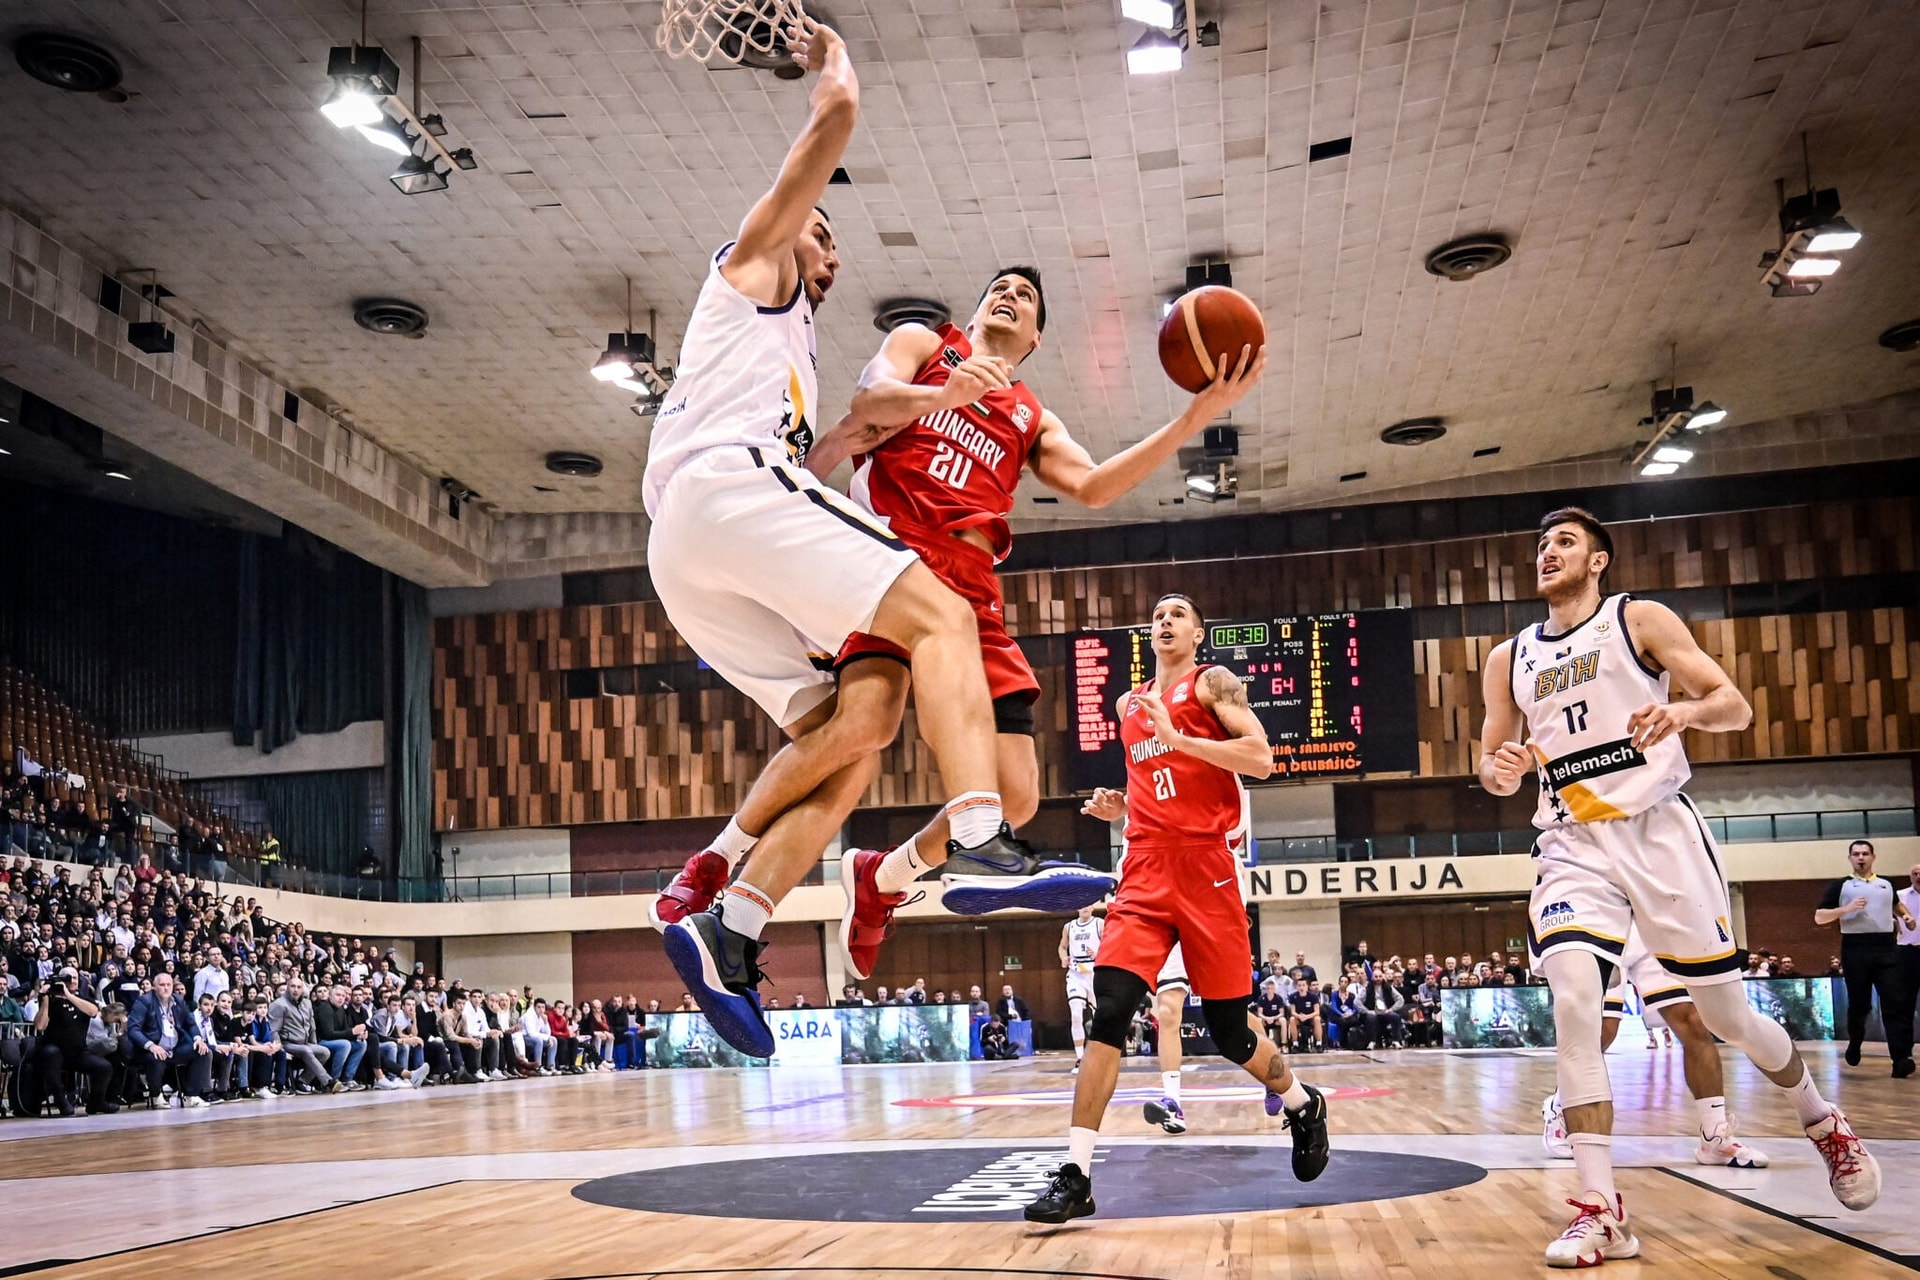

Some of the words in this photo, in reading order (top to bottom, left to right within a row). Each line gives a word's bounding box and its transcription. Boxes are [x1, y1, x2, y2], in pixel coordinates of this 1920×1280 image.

[927, 440, 973, 490] 20
[1273, 617, 1297, 625] FOULS
[1348, 618, 1356, 628] 2
[1215, 626, 1264, 646] 08:38
[1281, 624, 1291, 639] 0
[1310, 659, 1321, 670] 11
[1311, 669, 1322, 679] 12
[1271, 676, 1295, 695] 64
[1272, 699, 1302, 707] PENALTY
[1562, 700, 1589, 735] 17
[1299, 741, 1356, 755] SARAJEVO
[1552, 745, 1635, 782] telemach
[1152, 767, 1177, 801] 21
[1251, 863, 1464, 896] NDERIJA
[1540, 901, 1575, 921] ASA
[1540, 914, 1575, 932] GROUP
[779, 1021, 832, 1040] SARA
